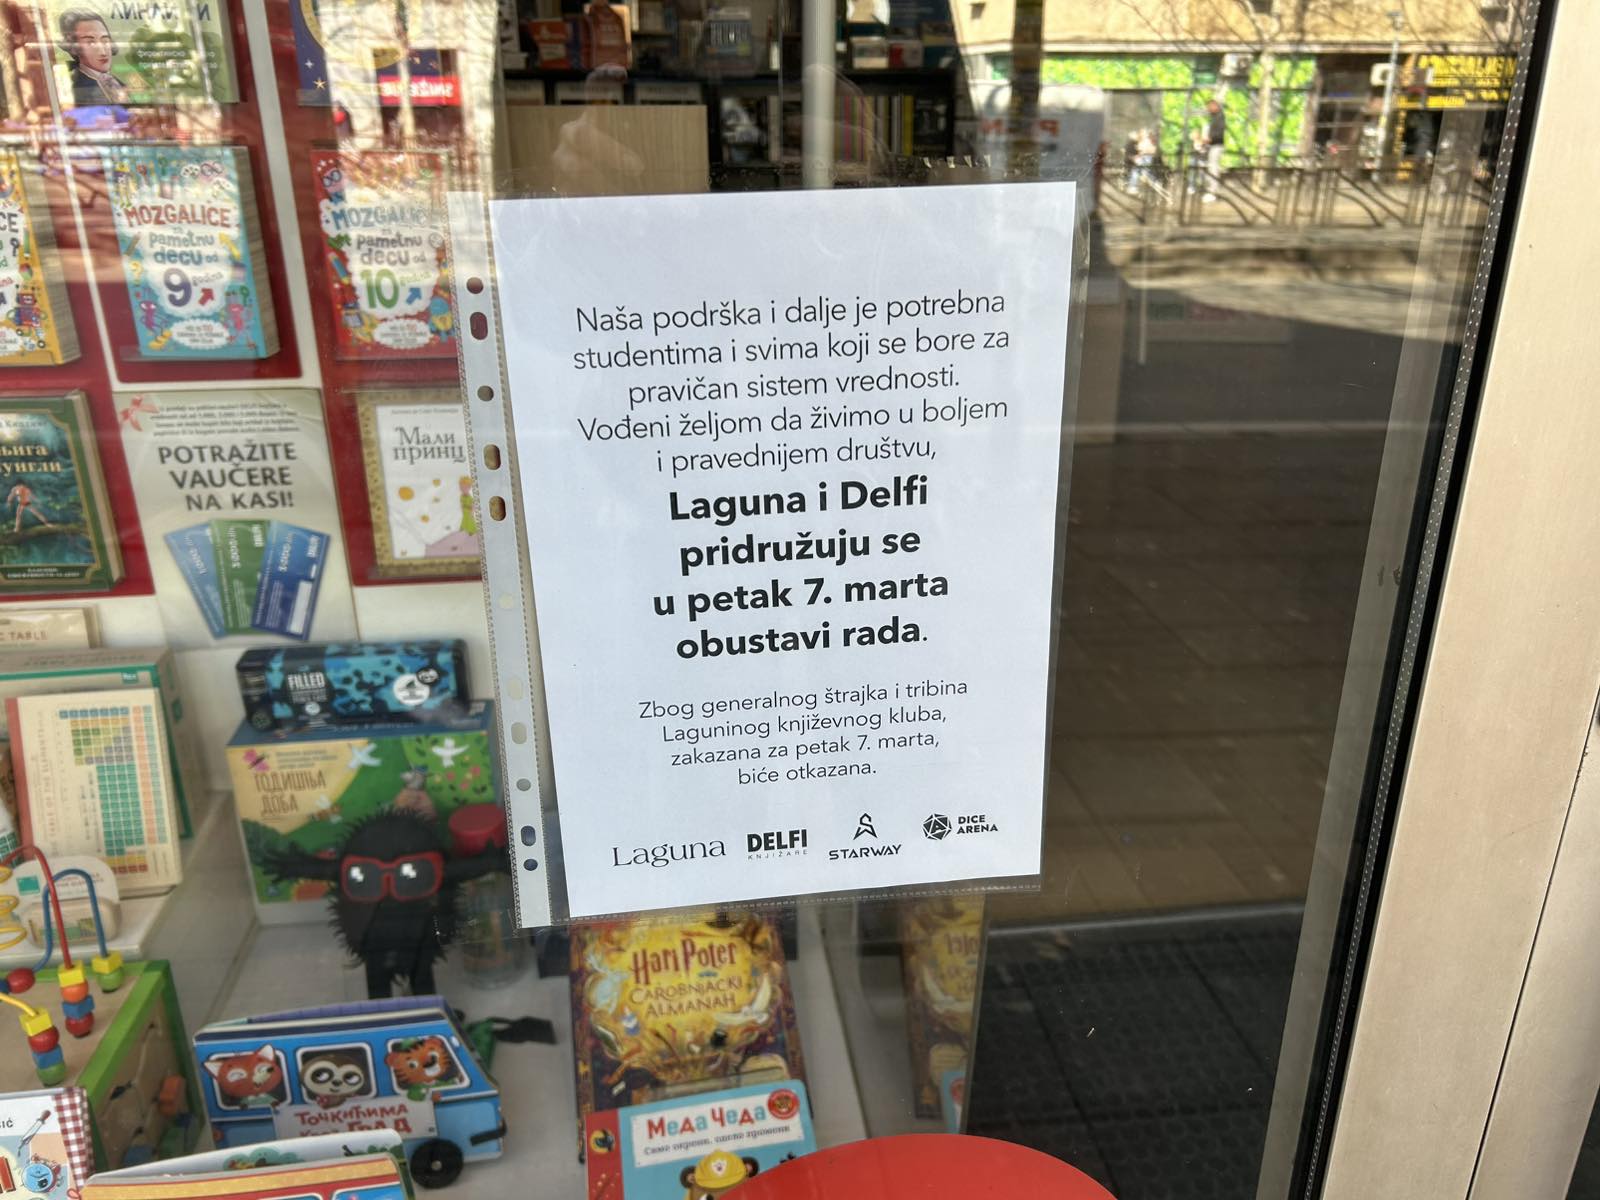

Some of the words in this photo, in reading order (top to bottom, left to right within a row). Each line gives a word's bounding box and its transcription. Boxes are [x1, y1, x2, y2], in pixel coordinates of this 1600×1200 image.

[123, 203, 232, 227] MOZGALICE
[149, 231, 215, 248] pametnu
[356, 232, 423, 249] pametnu
[153, 246, 202, 265] decu
[360, 248, 410, 266] decu
[163, 267, 193, 308] 9
[360, 268, 400, 309] 10
[576, 305, 644, 333] Naša
[652, 299, 762, 337] podrška
[770, 299, 776, 324] i
[784, 295, 847, 329] dalje
[853, 296, 877, 327] je
[886, 288, 1005, 326] potrebna
[573, 341, 722, 369] studentima
[731, 338, 737, 363] i
[744, 336, 818, 362] svima
[828, 331, 869, 363] koji
[878, 336, 906, 355] se
[915, 327, 976, 353] bore
[982, 330, 1010, 349] za
[628, 376, 739, 411] pravičan
[746, 373, 828, 398] sistem
[835, 364, 960, 393] vrednosti.
[577, 414, 671, 441] Vođeni
[678, 410, 762, 442] željom
[770, 406, 802, 432] da
[810, 405, 890, 430] živimo
[899, 407, 914, 424] u
[922, 396, 1008, 427] boljem
[394, 426, 455, 446] Мали
[157, 439, 297, 465] POTRAŽITE
[393, 445, 467, 465] принц
[656, 449, 662, 473] i
[671, 442, 828, 479] pravednijem
[836, 436, 937, 462] društvu,
[0, 460, 62, 478] унгли
[169, 461, 293, 490] VAUČERE
[186, 494, 222, 512] NA
[231, 490, 294, 510] KASI!
[669, 491, 806, 526] Laguna
[818, 481, 828, 511] i
[840, 474, 929, 510] Delfi
[679, 528, 871, 577] pridružuju
[881, 531, 921, 555] se
[653, 595, 675, 616] u
[687, 579, 793, 622] petak
[803, 577, 833, 606] 7.
[844, 573, 950, 603] marta
[676, 620, 831, 660] obustavi
[842, 615, 929, 648] rada.
[287, 671, 326, 690] FILLED
[638, 701, 694, 721] Zbog
[701, 690, 818, 718] generalnog
[824, 684, 889, 706] štrajka
[895, 682, 900, 700] i
[905, 679, 968, 699] tribina
[662, 720, 770, 744] Laguninog
[777, 711, 882, 735] književnog
[889, 706, 947, 725] kluba,
[671, 748, 761, 766] zakazana
[767, 745, 788, 758] za
[796, 735, 851, 760] petak
[857, 734, 871, 751] 7.
[877, 731, 940, 750] marta,
[254, 769, 327, 793] ГОДИШЊА
[738, 767, 779, 785] biće
[785, 763, 877, 782] otkazana.
[260, 793, 299, 816] ДОБА
[956, 823, 999, 835] ARENA
[957, 814, 986, 825] DICE
[746, 828, 808, 853] DELFI
[828, 843, 902, 861] STARWAY
[612, 839, 726, 869] Laguna
[631, 948, 679, 986] Hari
[681, 937, 737, 974] Poter
[645, 993, 736, 1018] ALMANAH
[647, 1115, 708, 1140] Меда
[711, 1104, 766, 1128] Чеда
